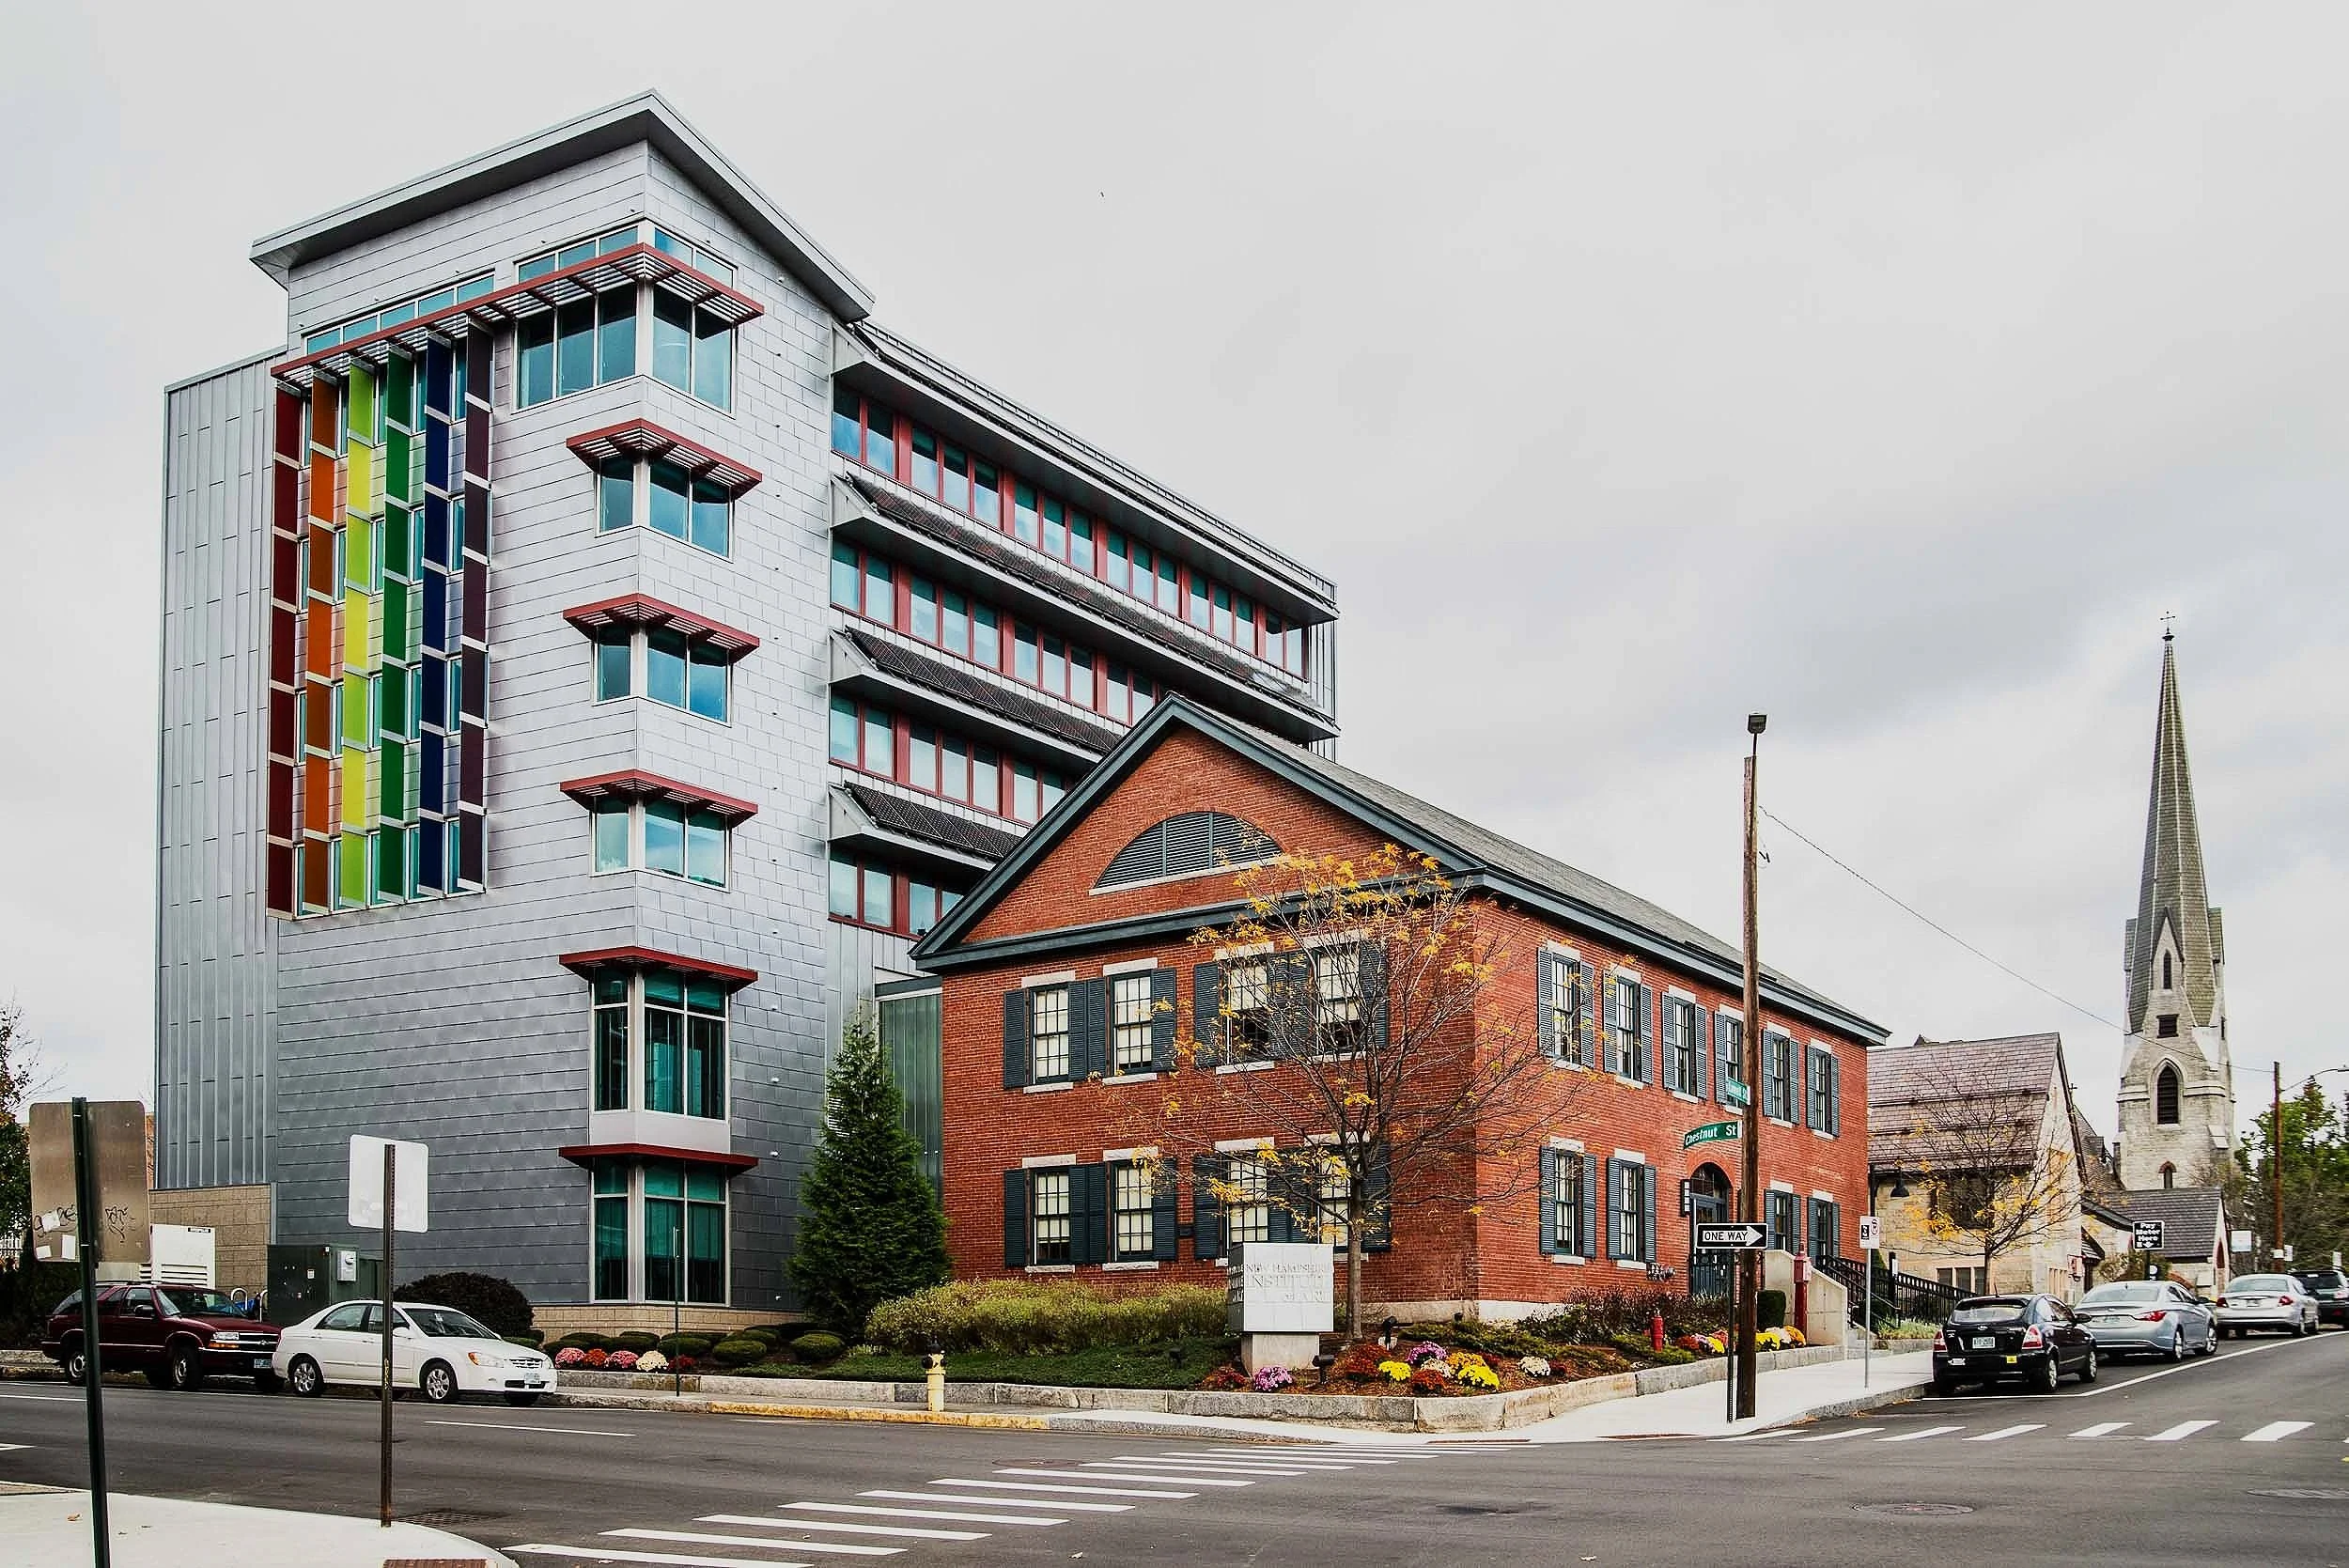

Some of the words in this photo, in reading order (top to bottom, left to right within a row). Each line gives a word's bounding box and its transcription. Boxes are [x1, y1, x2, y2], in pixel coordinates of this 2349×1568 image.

[1686, 1127, 1718, 1145] Chestnut
[1726, 1125, 1736, 1136] St
[1704, 1232, 1724, 1241] ONE
[1728, 1232, 1748, 1241] WAY
